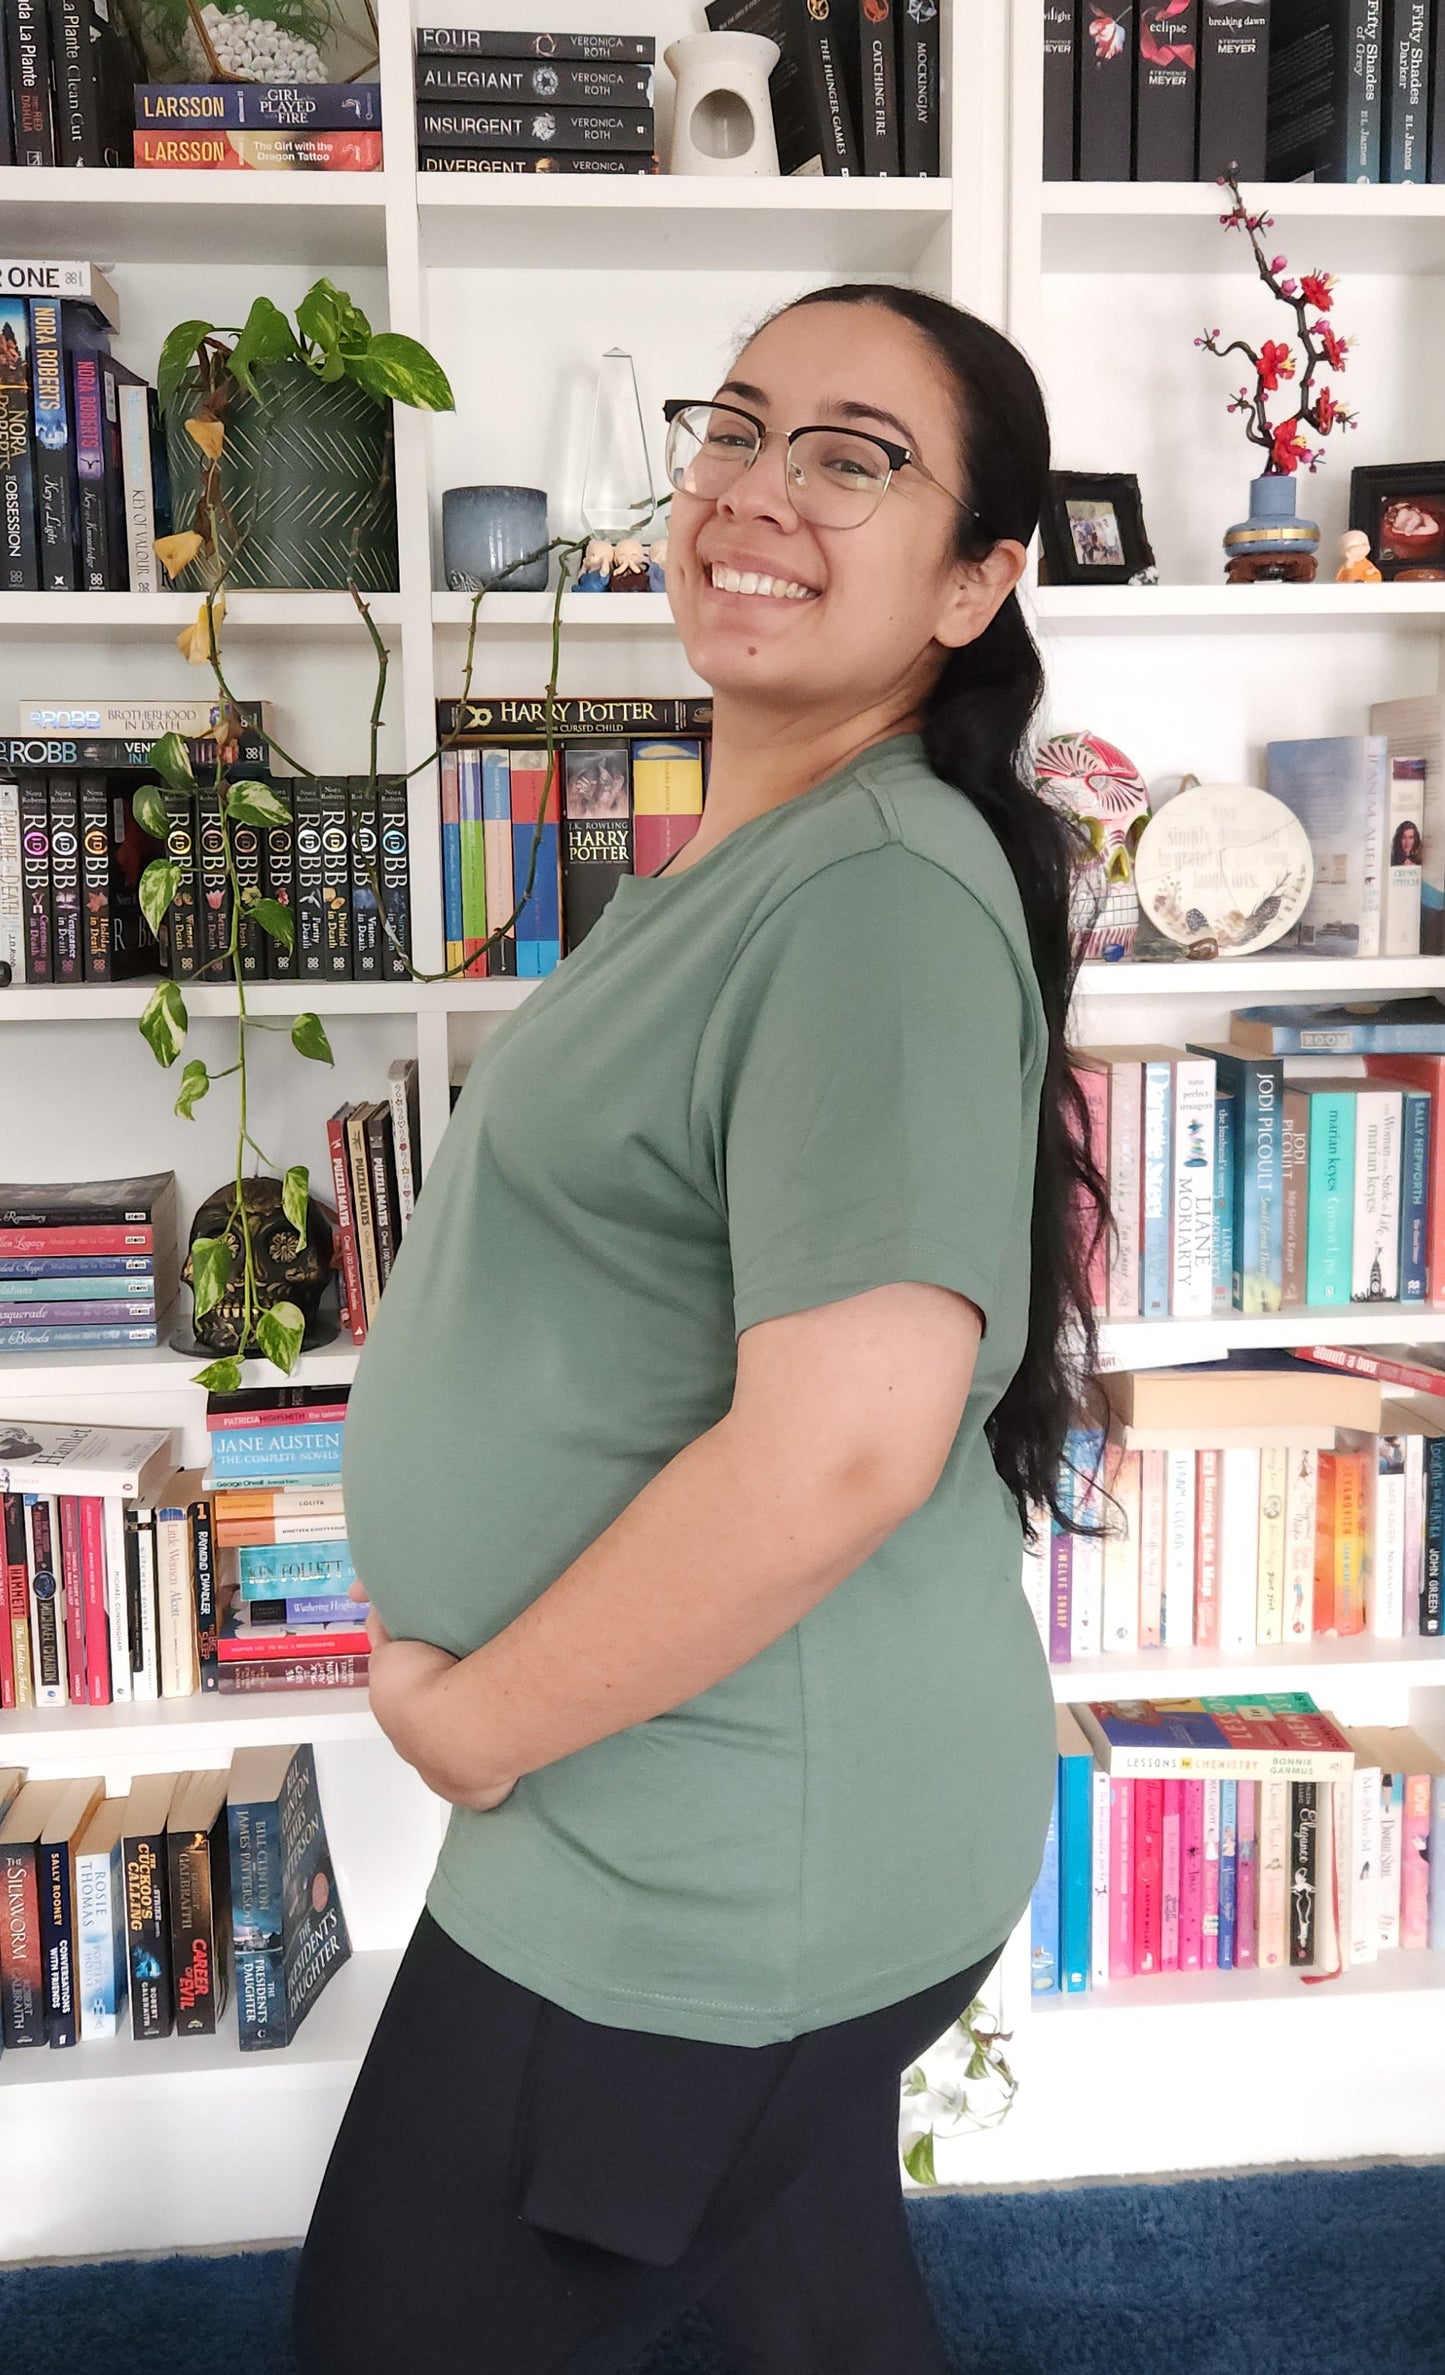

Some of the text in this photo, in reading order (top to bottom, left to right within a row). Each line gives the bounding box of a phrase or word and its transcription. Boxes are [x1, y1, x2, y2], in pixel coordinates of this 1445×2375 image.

[64, 16, 80, 58] Plante
[423, 30, 481, 49] FOUR
[570, 36, 624, 48] VERONICA
[1149, 21, 1187, 44] eclipse
[1208, 15, 1266, 32] breaking dawn
[19, 26, 37, 87] La Plante
[583, 47, 611, 58] ROTH
[1218, 44, 1257, 54] MEYER
[1354, 26, 1365, 77] of Grey
[1364, 0, 1379, 101] Fifty Shades
[1399, 41, 1410, 89] Darker
[1409, 4, 1424, 105] Fifty Shades
[267, 89, 298, 101] GIRL
[424, 70, 523, 90] ALLEGIANT
[571, 73, 624, 84] VERONICA
[584, 85, 611, 96] ROTH
[820, 37, 846, 156] THE HUNGER GAMES
[872, 40, 886, 136] CATCHING FIRE
[916, 42, 929, 124] MOCKINGJAY
[1148, 76, 1187, 86] MEYER
[67, 65, 84, 142] Clean Cut
[143, 96, 225, 118] LARSSON
[260, 101, 316, 113] PLAYED
[278, 112, 309, 124] FIRE
[571, 118, 624, 128] VERONICA
[253, 141, 333, 152] The Girl with the
[424, 117, 523, 136] INSURGENT
[584, 130, 611, 140] ROTH
[143, 141, 225, 162] LARSSON
[257, 152, 330, 163] Dragon Tattoo
[426, 159, 526, 172] DIVERGENT
[572, 161, 625, 171] VERONICA
[8, 267, 60, 288] ONE
[35, 307, 60, 411] NORA ROBERTS
[77, 361, 98, 448] NORA ROBERTS
[9, 410, 27, 457] NORA
[5, 481, 21, 557] OBSESSION
[45, 511, 60, 545] Light
[132, 489, 150, 576] KEY VALOUR
[108, 710, 196, 720] BROTHERHOOD
[124, 721, 180, 731] IN DEATH
[500, 700, 658, 723] HARRY POTTER
[559, 724, 624, 733] CURSED CHILD
[10, 741, 77, 763] ROBB
[568, 831, 630, 848] HARRY
[585, 821, 629, 831] ROWLING
[23, 814, 49, 889] ROBB
[51, 814, 78, 889] ROBB
[84, 813, 109, 888] ROBB
[201, 813, 226, 888] ROBB
[297, 813, 322, 887] ROBB
[322, 810, 348, 886] ROBB
[382, 813, 407, 888] ROBB
[569, 847, 630, 861] POTTER
[68, 913, 78, 958] Vengeance
[313, 917, 321, 944] Purity
[338, 913, 348, 948] Divided
[367, 916, 376, 949] Visions
[1302, 1032, 1349, 1047] ROOM
[1256, 1072, 1275, 1192] JODI PICOULT
[1282, 1119, 1293, 1180] PICOULT
[1294, 1132, 1306, 1165] JODI
[1326, 1109, 1341, 1192] marian keyes
[1364, 1123, 1380, 1214] marian keyes
[1411, 1101, 1426, 1205] SALLY HEPWORTH
[333, 1158, 351, 1227] PUZZLE MATES
[355, 1157, 370, 1226] PUZZLE MATES
[374, 1157, 389, 1226] PUZZLE MATES
[1177, 1178, 1193, 1287] MORIARTY
[1194, 1196, 1211, 1268] LIANE
[1221, 1227, 1232, 1265] LIANE
[223, 1412, 306, 1426] PATRICIA HIGHSMITH
[32, 1428, 93, 1467] Hamlet
[217, 1432, 340, 1454] JANE AUSTEN
[219, 1451, 339, 1465] THE COMPLETE NOVELS
[216, 1480, 242, 1489] George
[167, 1523, 182, 1618] Little Women Alcott
[198, 1530, 209, 1571] RAYMOND
[10, 1568, 25, 1616] HAMMETT
[248, 1560, 343, 1583] KEN FOLLETT
[1427, 1548, 1439, 1614] JOHN GREEN
[114, 1571, 123, 1651] MICHAEL CUNNINGHAM
[293, 1600, 329, 1613] Wuthering
[1127, 1758, 1259, 1770] LESSONS CHEMISTRY
[1270, 1766, 1314, 1775] GARMUS
[1272, 1757, 1313, 1766] BONNIE
[1296, 1808, 1317, 1863] Elegance
[7, 1857, 22, 1866] THE
[138, 1843, 153, 1920] CUCKOO'S
[237, 1811, 252, 1925] JAMES PATTERSON
[255, 1821, 270, 1911] BILL CLINTON
[51, 1853, 63, 1926] SALLY ROONEY
[81, 1861, 95, 1927] THOMAS
[94, 1871, 108, 1916] ROSIE
[127, 1861, 143, 1932] CALLING
[178, 1853, 193, 1930] GALBRAITH
[7, 1867, 28, 1960] SILKWORM
[49, 1947, 61, 2009] WITH FRIENDS
[59, 1939, 72, 2014] CONVERSATIONS
[191, 1938, 209, 1996] CAREER
[141, 1981, 151, 2027] GALBRAITH
[150, 1986, 158, 2019] ROBERT
[179, 1976, 195, 2011] EVIL
[243, 1962, 257, 2023] DAUGHTER
[256, 1959, 268, 2024] PRESIDENT'S
[267, 1982, 275, 1998] THE
